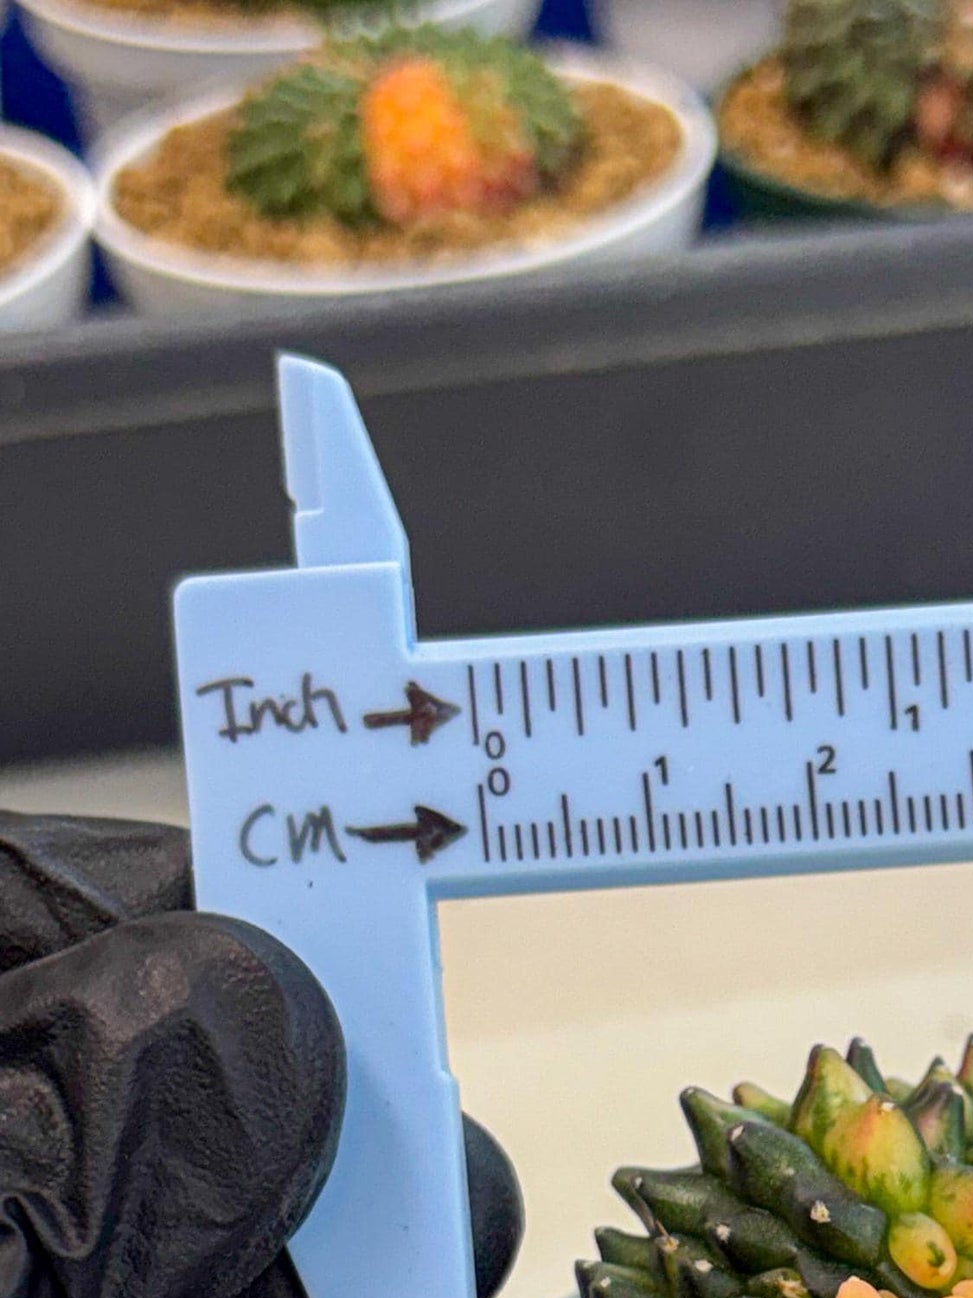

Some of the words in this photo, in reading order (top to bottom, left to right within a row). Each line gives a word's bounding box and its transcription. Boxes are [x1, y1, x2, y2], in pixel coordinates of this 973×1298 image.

[196, 672, 348, 742] Inch
[484, 731, 506, 759] 0
[904, 705, 920, 731] 1
[487, 767, 511, 796] 0
[655, 756, 670, 785] 1
[816, 745, 837, 774] 2
